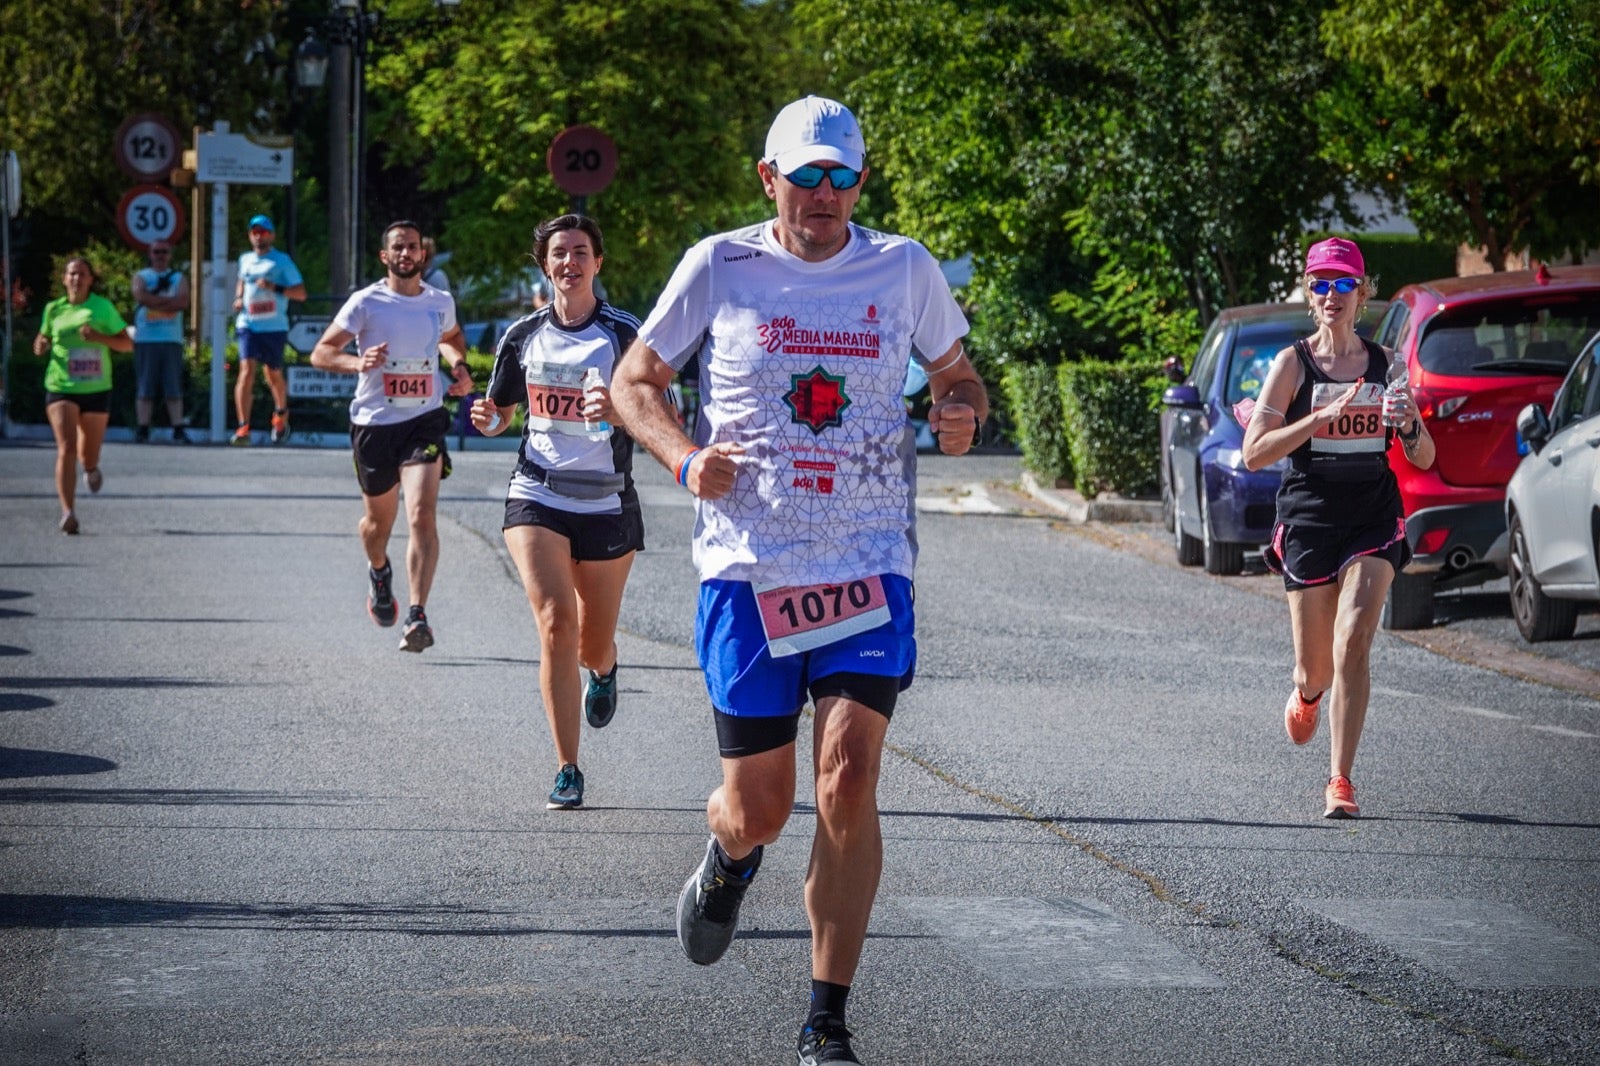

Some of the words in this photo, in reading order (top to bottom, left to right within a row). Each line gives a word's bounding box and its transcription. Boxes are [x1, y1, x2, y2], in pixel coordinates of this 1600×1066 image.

[129, 136, 166, 159] 12t
[565, 149, 601, 172] 20
[134, 205, 169, 231] 30
[771, 315, 796, 331] edp
[757, 324, 782, 353] 38
[783, 329, 821, 345] MEDIA
[824, 330, 880, 348] MARATÓN
[389, 379, 426, 395] 1041
[536, 392, 586, 418] 1079
[1328, 413, 1379, 436] 1068
[779, 579, 871, 628] 1070
